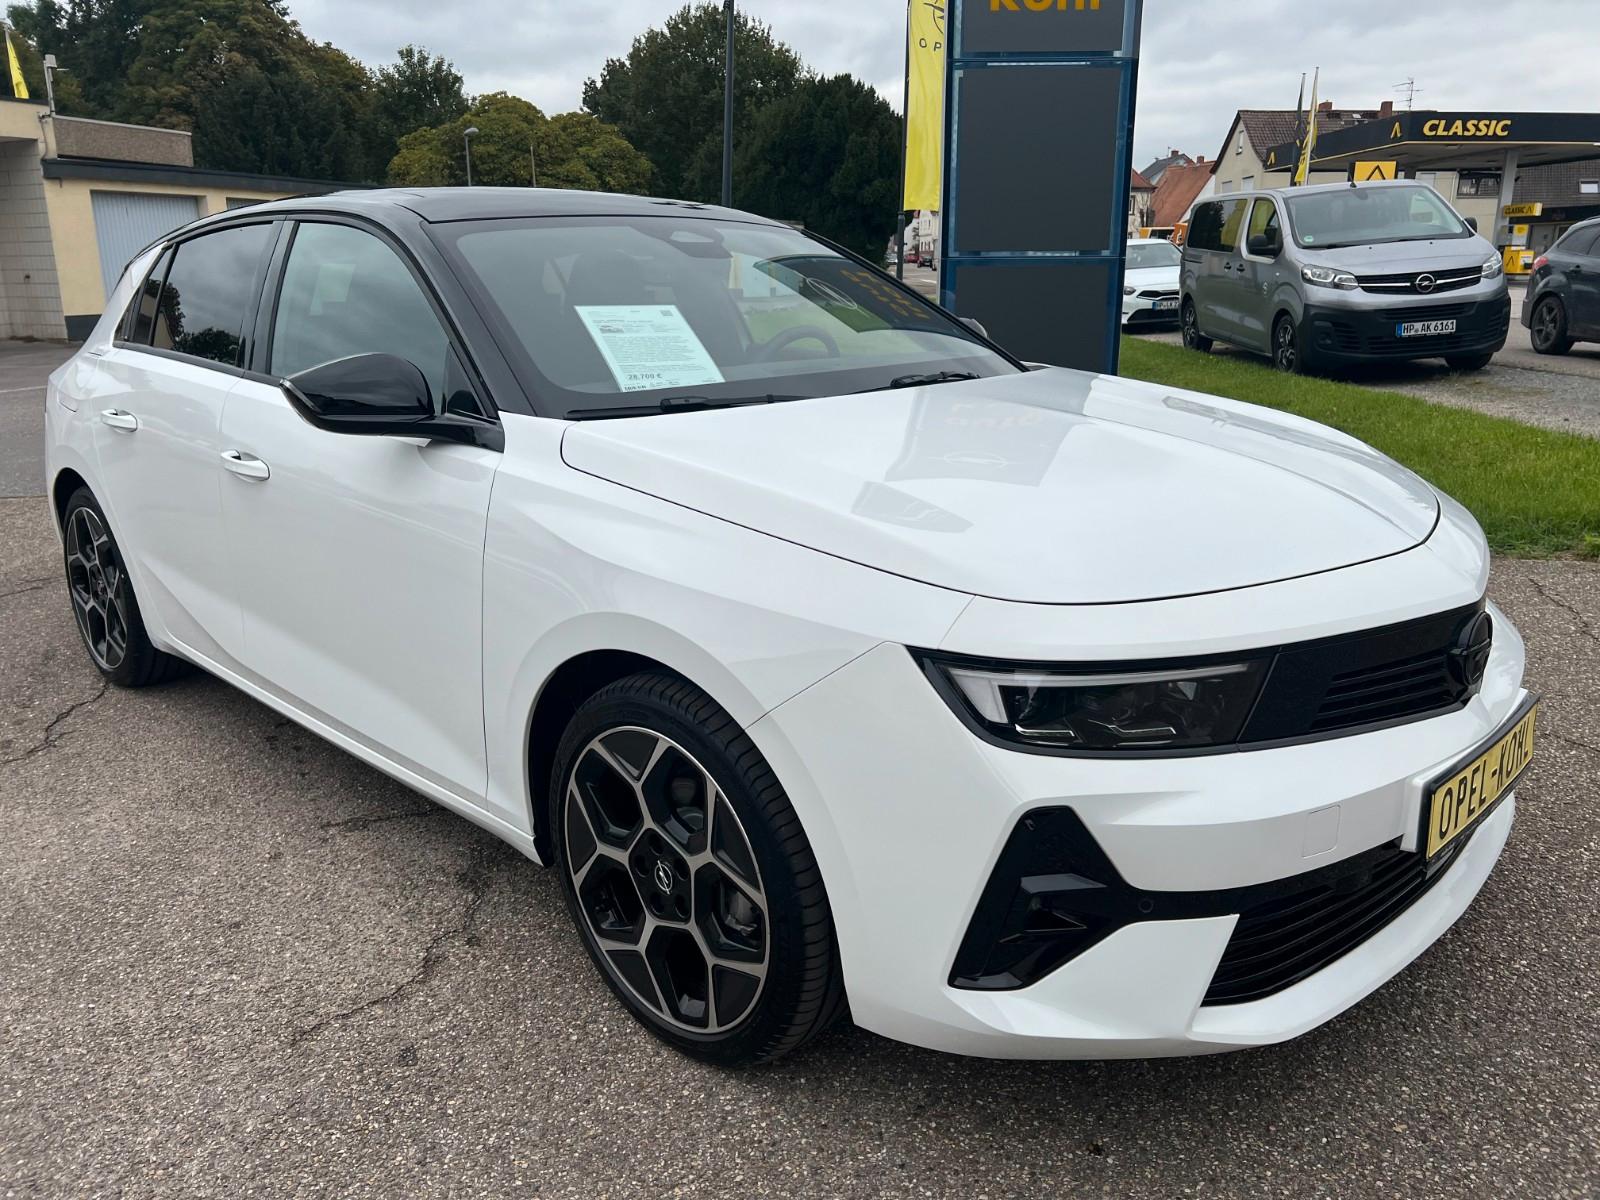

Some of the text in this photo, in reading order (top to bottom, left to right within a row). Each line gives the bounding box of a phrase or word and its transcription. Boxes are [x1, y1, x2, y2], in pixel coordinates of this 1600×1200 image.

[1422, 119, 1512, 136] CLASSIC
[1403, 320, 1455, 334] HP AK 6161
